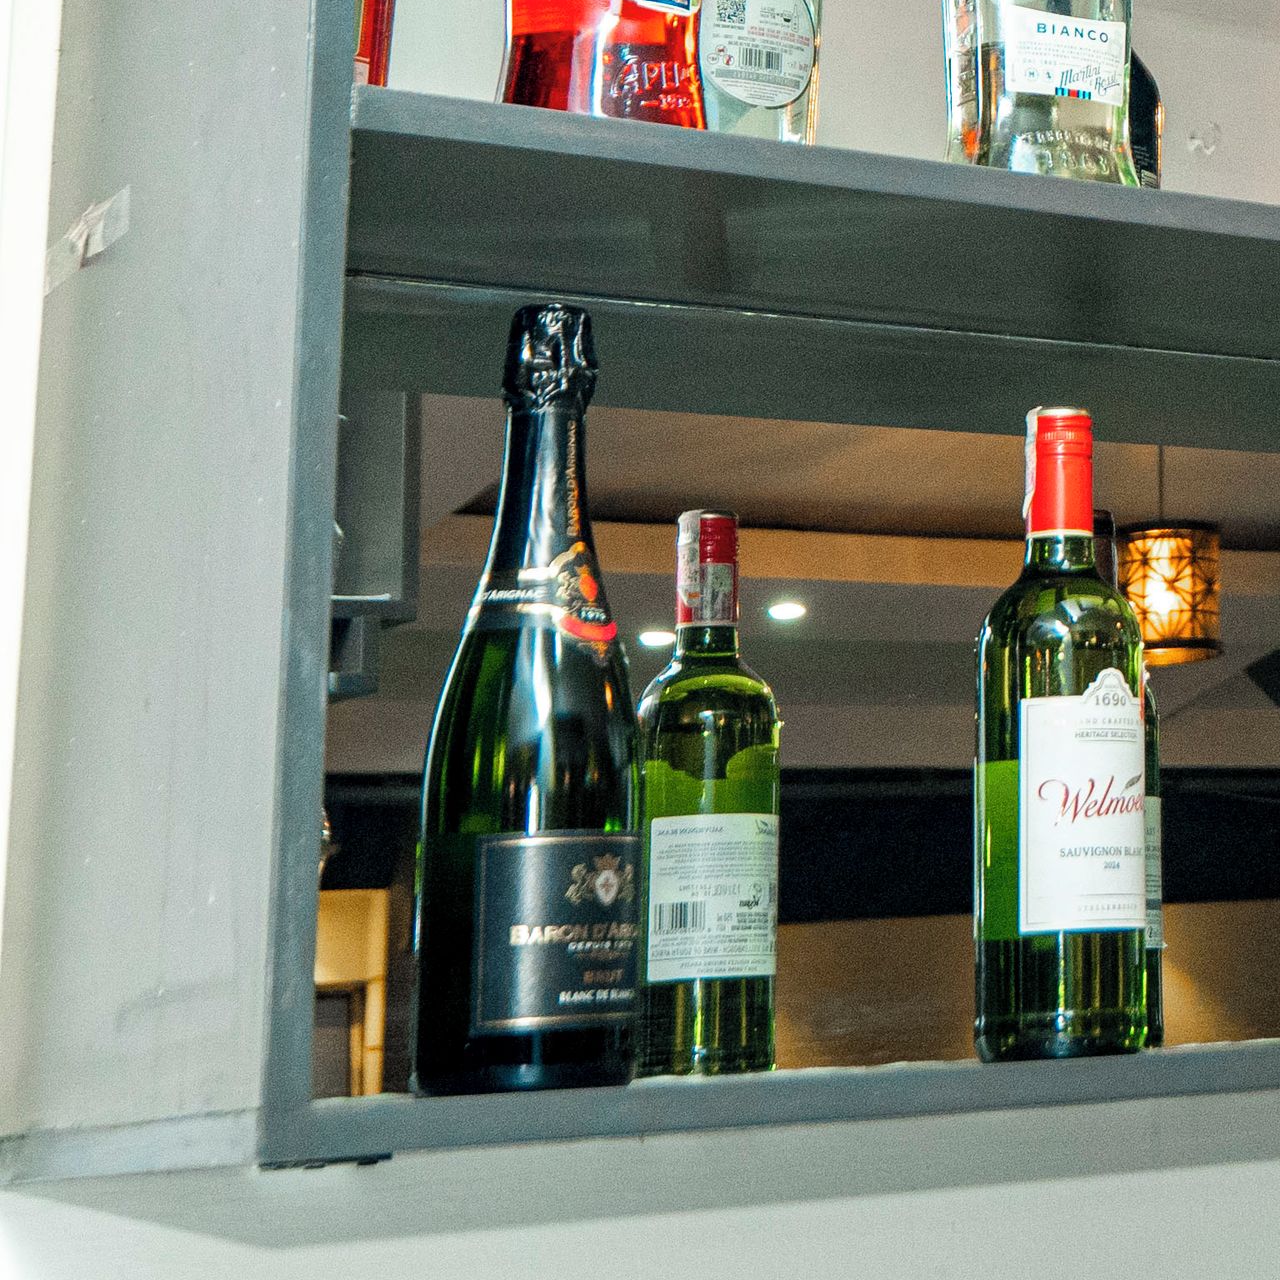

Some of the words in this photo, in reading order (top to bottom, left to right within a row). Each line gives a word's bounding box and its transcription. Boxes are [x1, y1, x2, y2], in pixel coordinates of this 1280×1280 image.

[1036, 22, 1109, 44] BIANCO
[566, 492, 581, 537] BARON
[1094, 692, 1128, 707] 1690
[1059, 845, 1123, 858] SAUVIGNON
[509, 924, 590, 947] BARON
